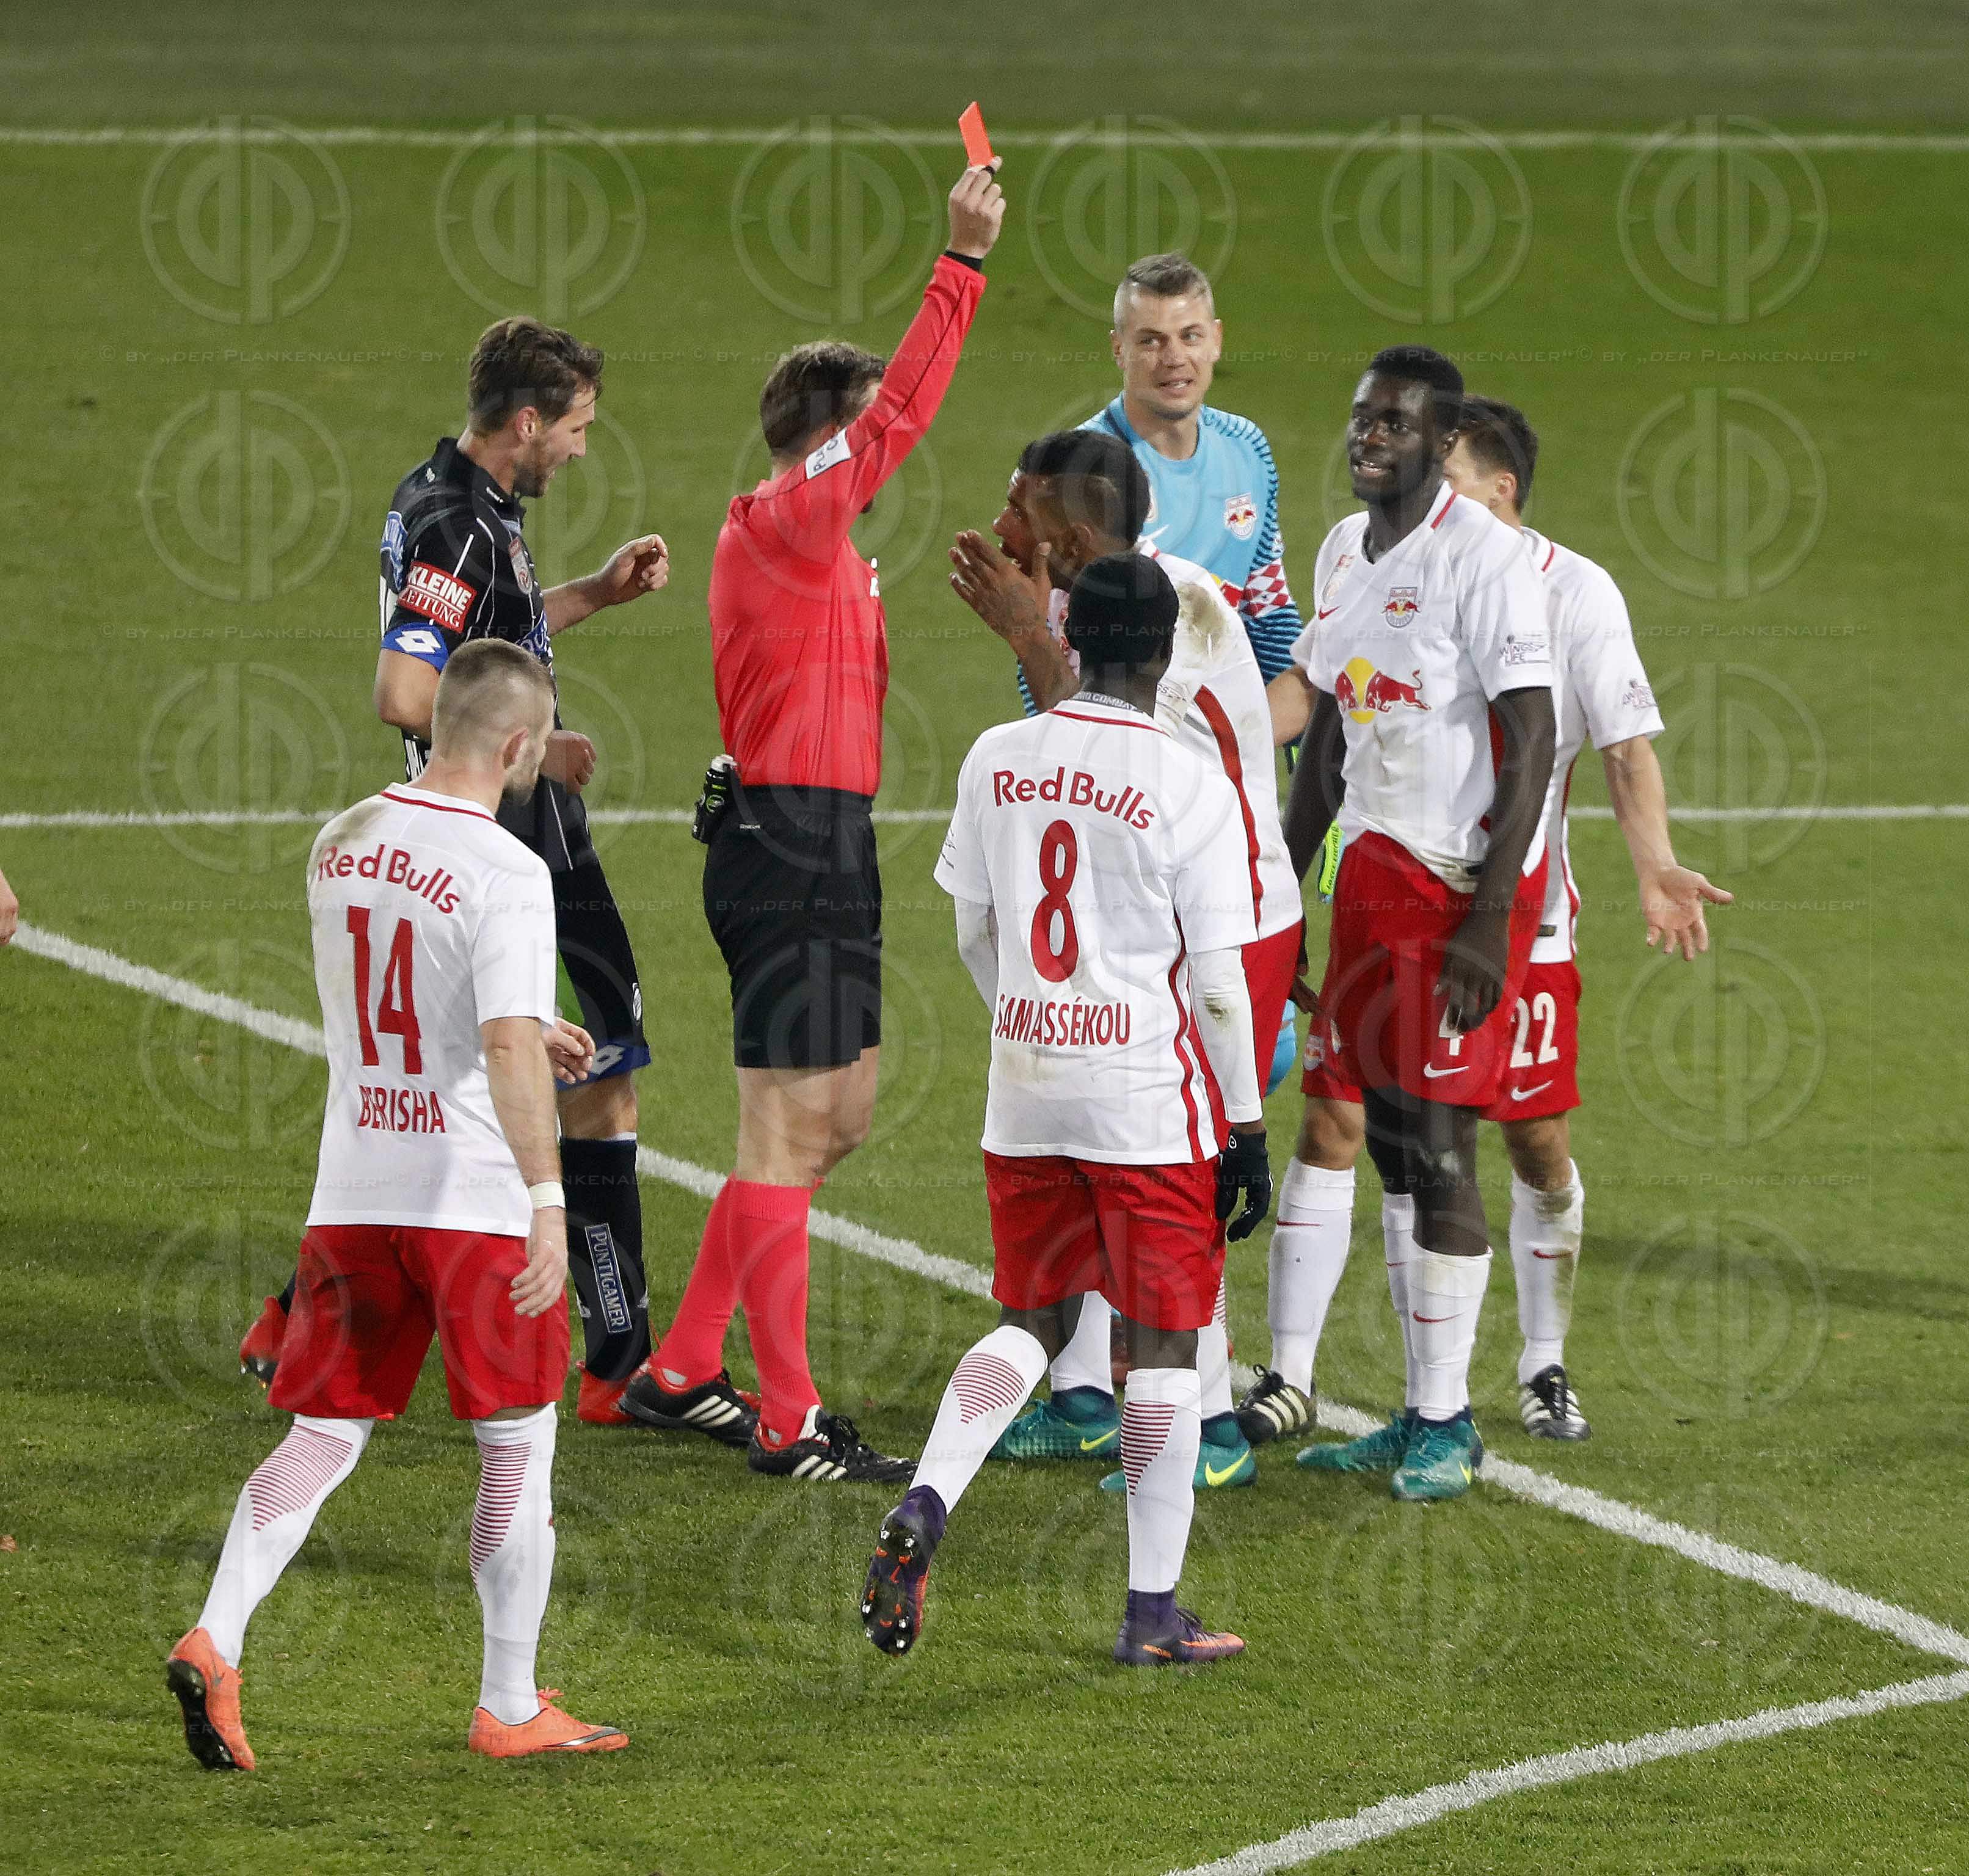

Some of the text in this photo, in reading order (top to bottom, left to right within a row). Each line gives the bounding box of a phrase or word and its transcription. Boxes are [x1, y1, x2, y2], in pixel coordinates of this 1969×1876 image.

[407, 565, 472, 611] KLEINE
[1030, 819, 1080, 983] 8
[346, 904, 423, 1075] 14
[994, 993, 1131, 1046] SAMASSÉKOU
[1509, 991, 1559, 1069] 22
[357, 1084, 446, 1133] BERISHA
[590, 1230, 626, 1328] PUNTIGAMER
